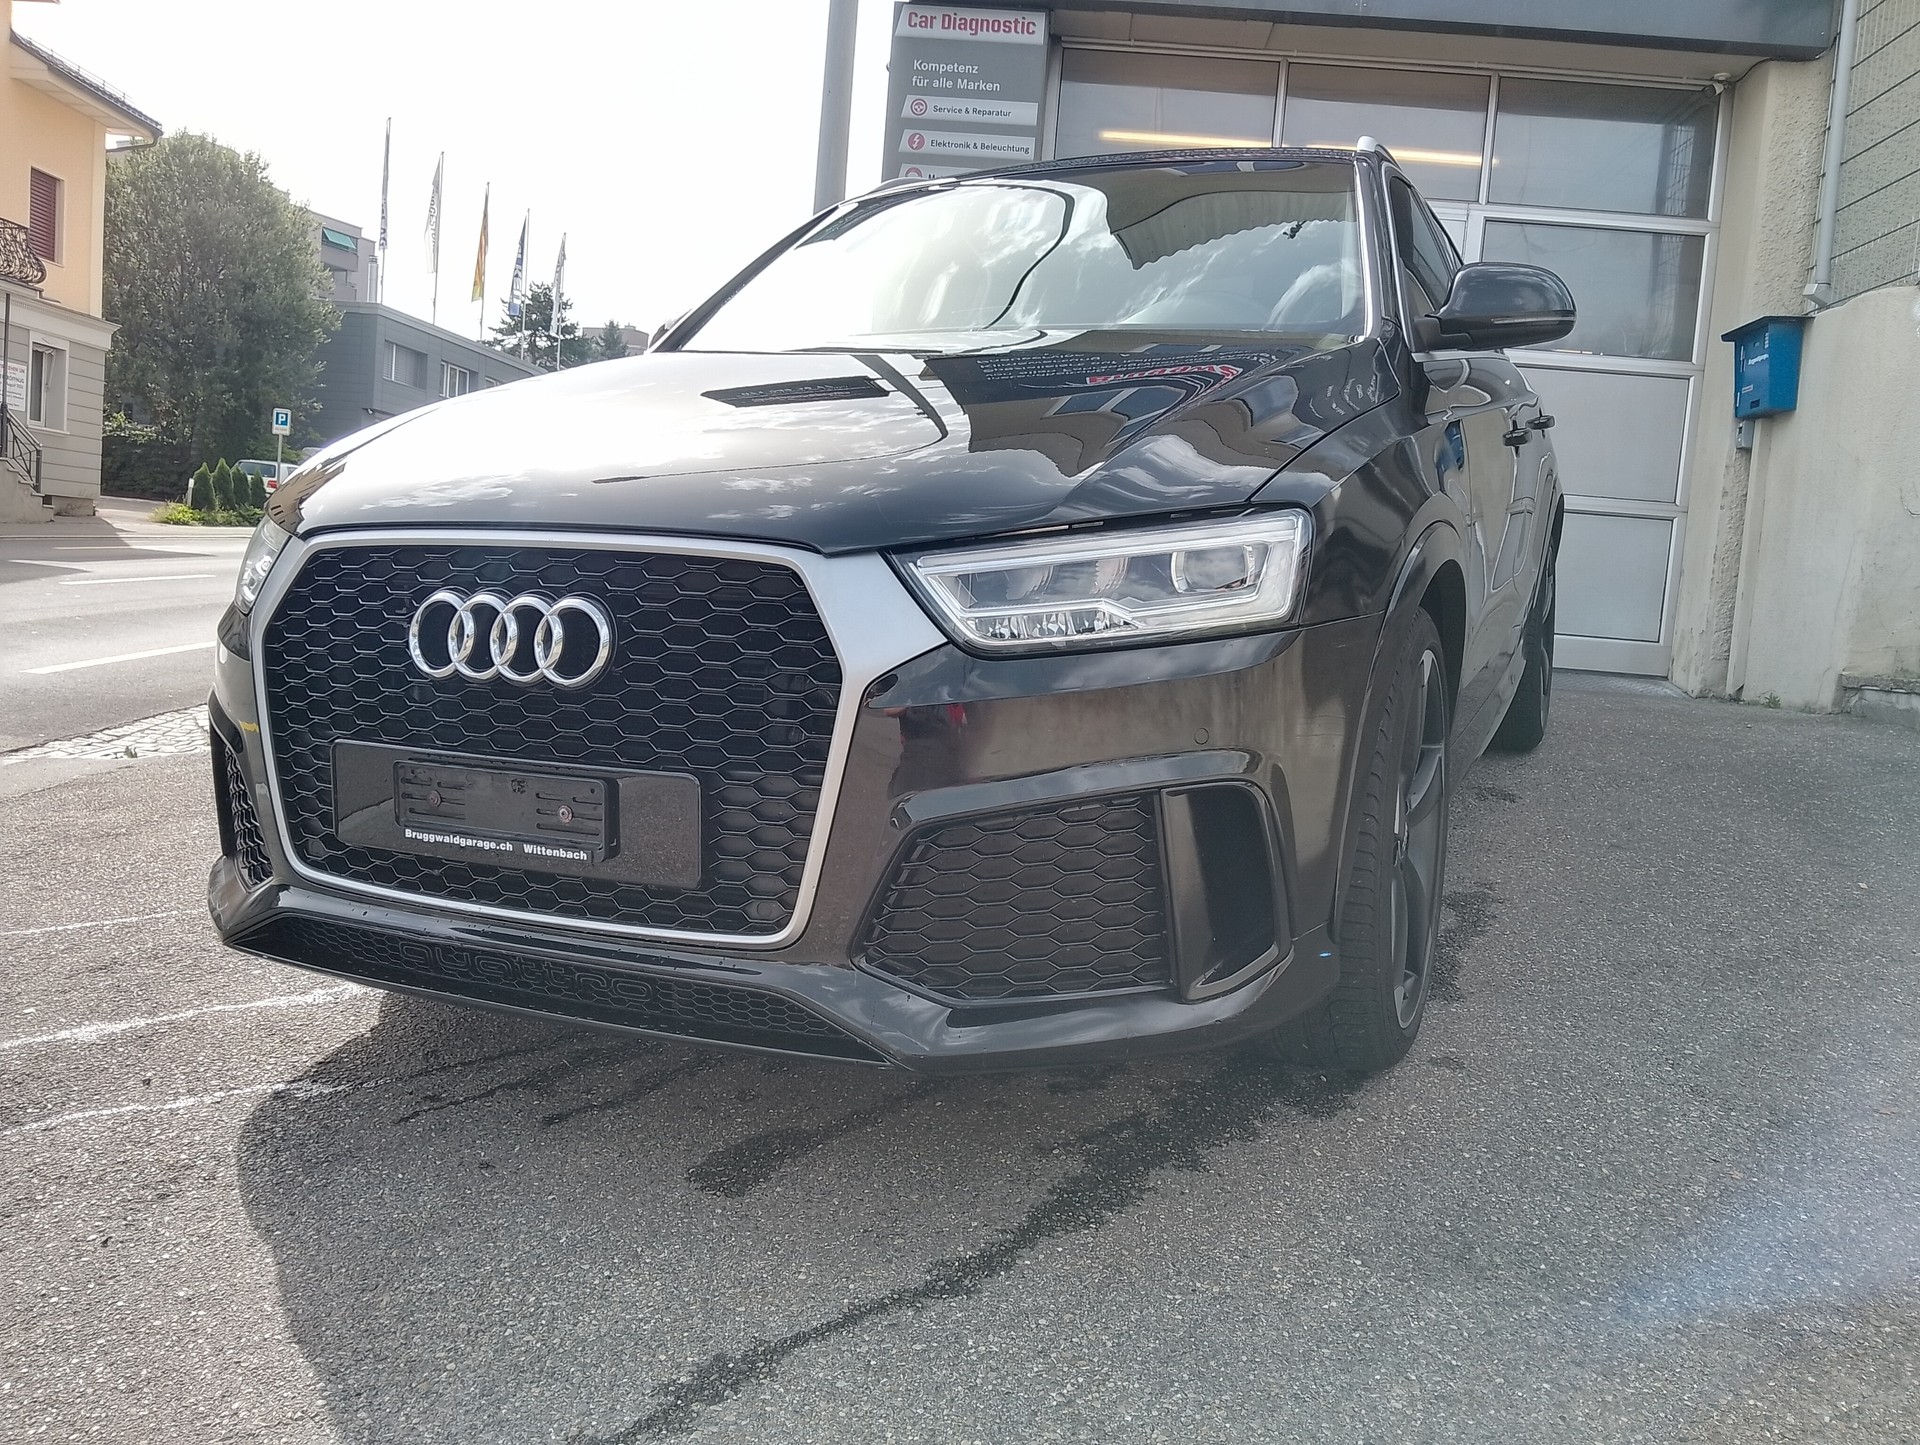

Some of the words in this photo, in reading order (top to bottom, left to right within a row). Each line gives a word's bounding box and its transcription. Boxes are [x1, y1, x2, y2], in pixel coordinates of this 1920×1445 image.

[907, 11, 937, 30] Car
[941, 13, 1037, 36] Diagnostic
[913, 59, 979, 75] Kompetenz
[912, 75, 930, 88] für
[932, 77, 953, 89] alle
[956, 78, 1001, 92] Marken
[932, 105, 963, 115] Service
[964, 107, 970, 115] &
[972, 107, 1012, 118] Reparatur
[930, 139, 971, 150] Elektronik
[972, 142, 979, 150] &
[980, 142, 1030, 155] Beleuchtung
[404, 828, 514, 852] Bruggwaldgarage.ch
[523, 843, 588, 861] Wittenbach
[399, 941, 653, 1001] quattro
